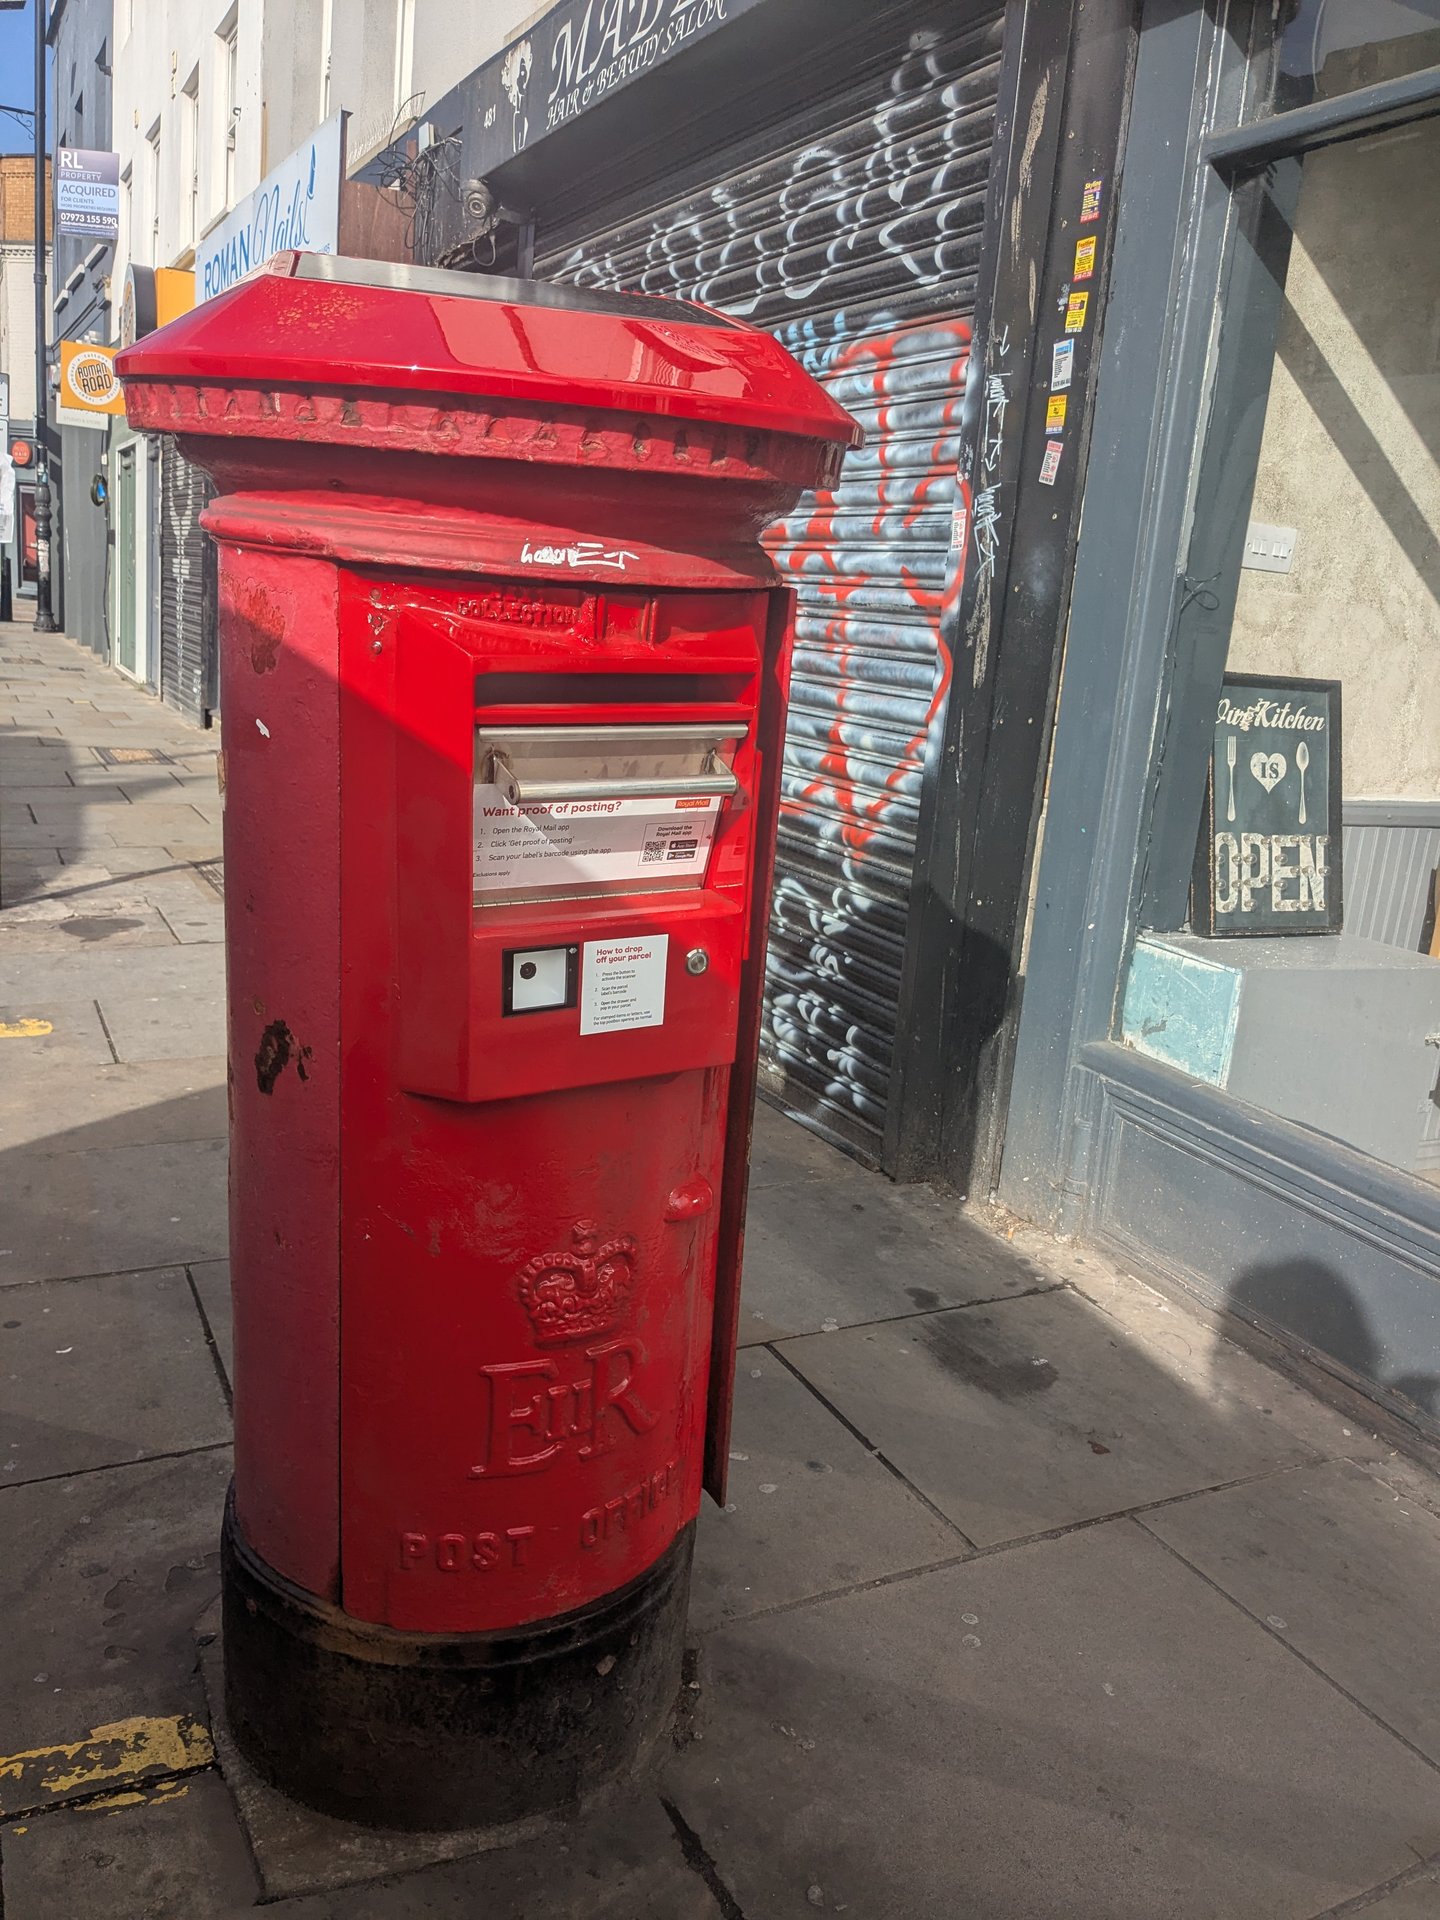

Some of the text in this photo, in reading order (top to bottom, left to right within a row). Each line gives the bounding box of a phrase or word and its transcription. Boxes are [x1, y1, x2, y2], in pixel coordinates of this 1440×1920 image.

[548, 0, 698, 103] MAD
[546, 0, 727, 130] HAIR & BEAUTY SALON
[484, 104, 497, 129] 481
[61, 151, 83, 169] RL
[61, 171, 102, 181] PROPERTY
[62, 184, 116, 198] ACQUIRED
[61, 212, 84, 222] 07973
[86, 215, 100, 224] 155
[204, 179, 310, 300] ROMAN Nails
[78, 363, 107, 378] ROMAN
[82, 374, 111, 393] ROAD
[1254, 698, 1325, 731] Kitchen
[1261, 762, 1279, 779] IS
[483, 801, 622, 817] Want proof of posting?
[677, 800, 694, 808] Royal
[524, 825, 541, 834] Royal
[543, 824, 556, 832] Mail
[490, 840, 507, 848] Click
[522, 838, 540, 847] proof
[506, 853, 521, 862] your
[522, 851, 543, 859] label's
[544, 850, 569, 858] barcode
[571, 848, 587, 857] using
[600, 847, 611, 855] app
[1215, 832, 1325, 913] OPEN
[596, 952, 651, 964] off your parcel
[400, 1526, 534, 1571] POST
